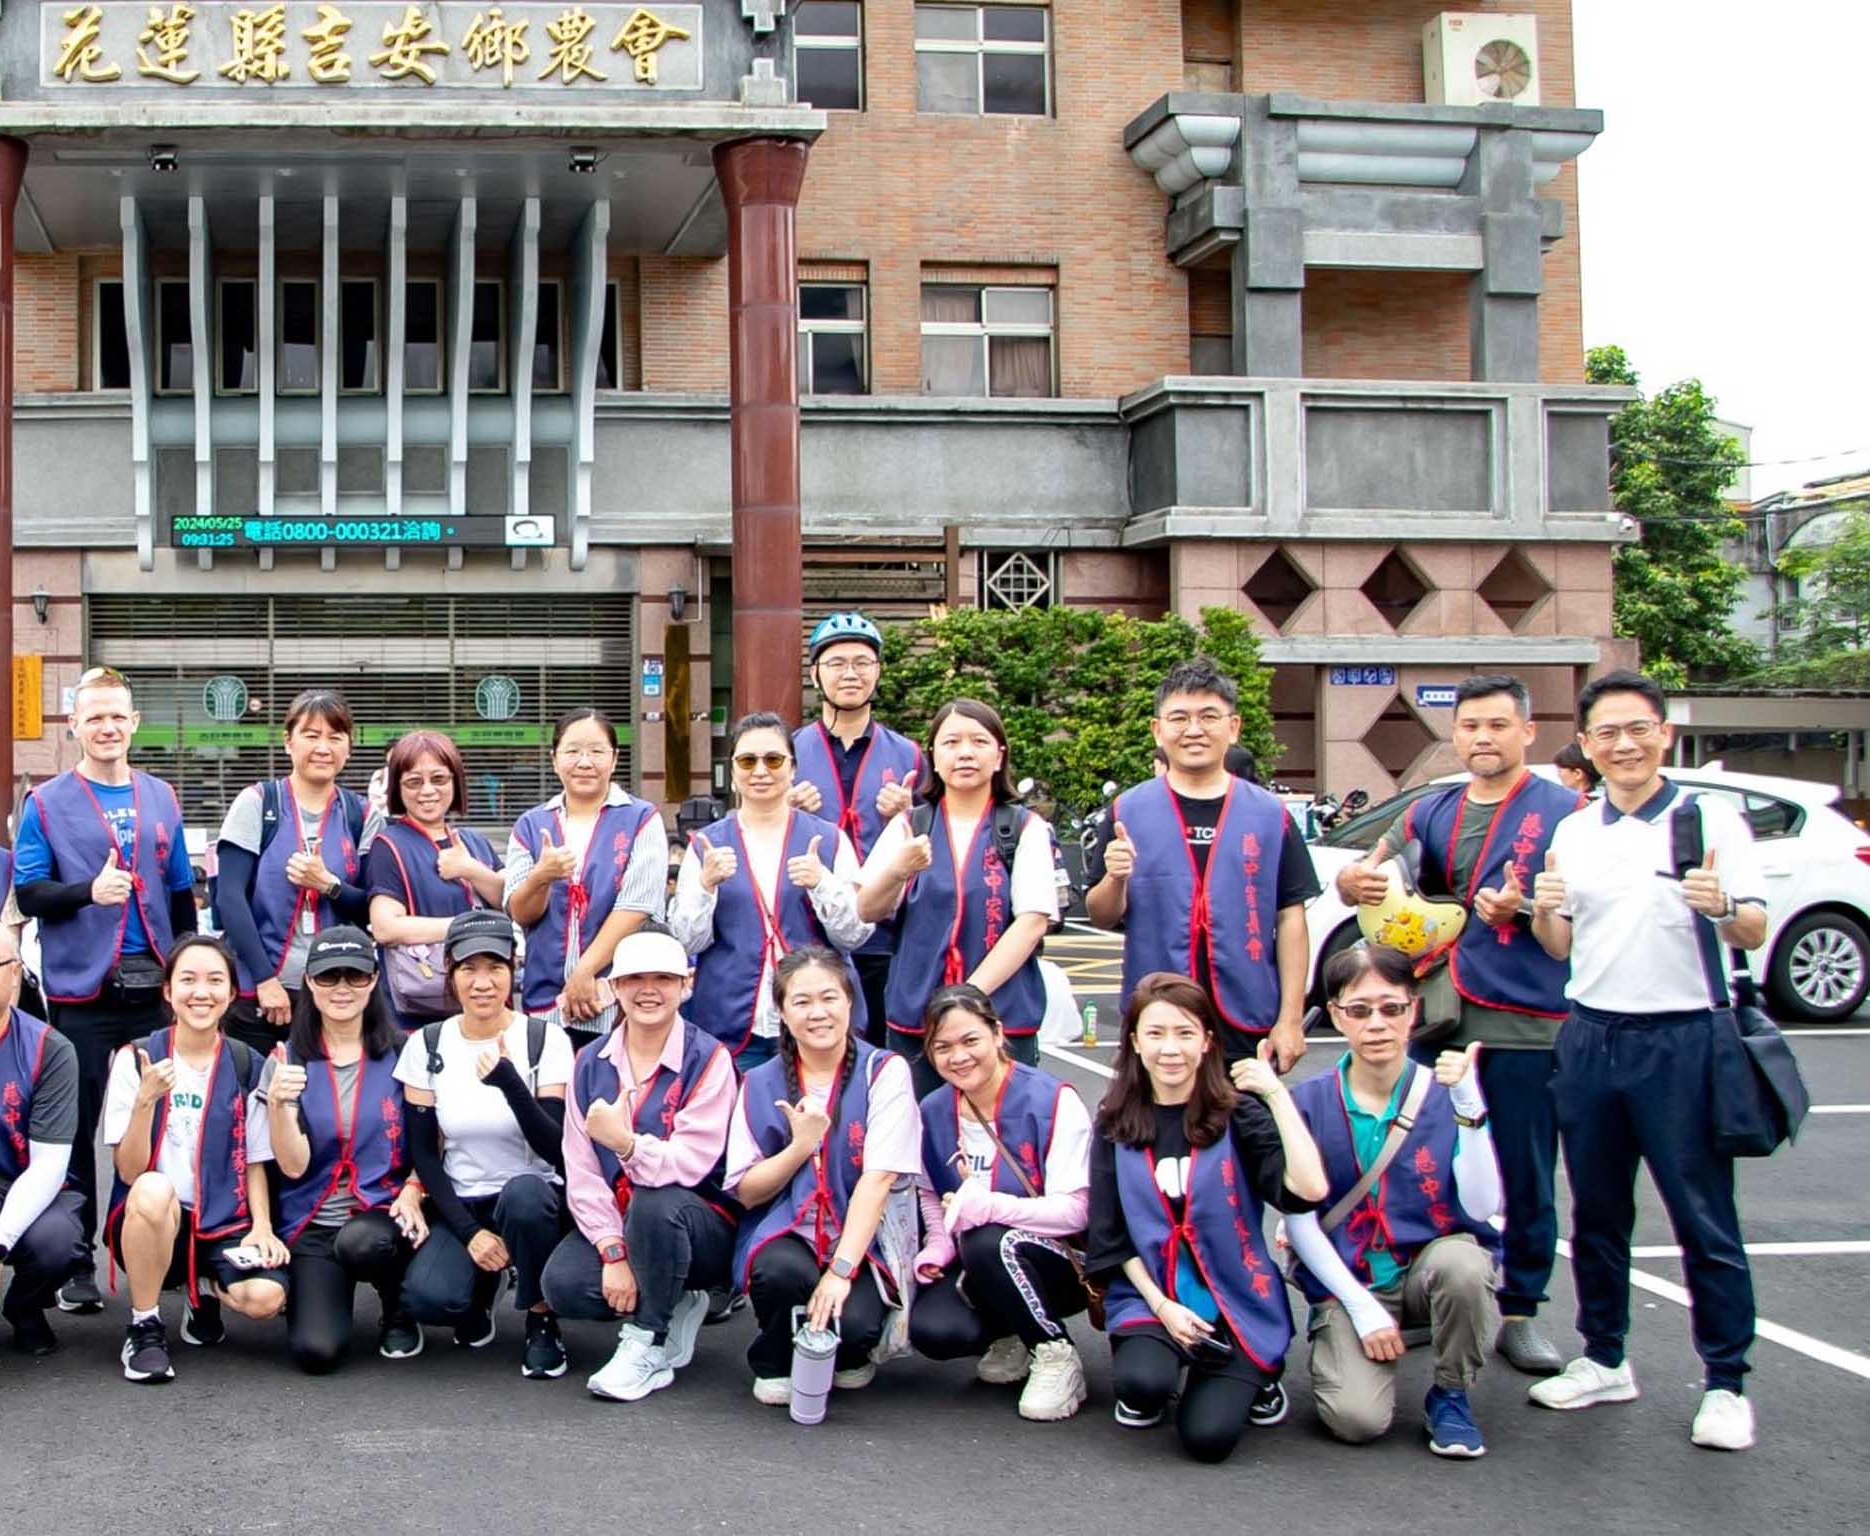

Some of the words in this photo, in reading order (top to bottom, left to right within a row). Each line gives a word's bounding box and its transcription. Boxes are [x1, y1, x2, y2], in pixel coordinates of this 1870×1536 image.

[53, 6, 691, 88] 花蓮縣吉安鄉農會
[174, 517, 243, 531] 2024/05/25
